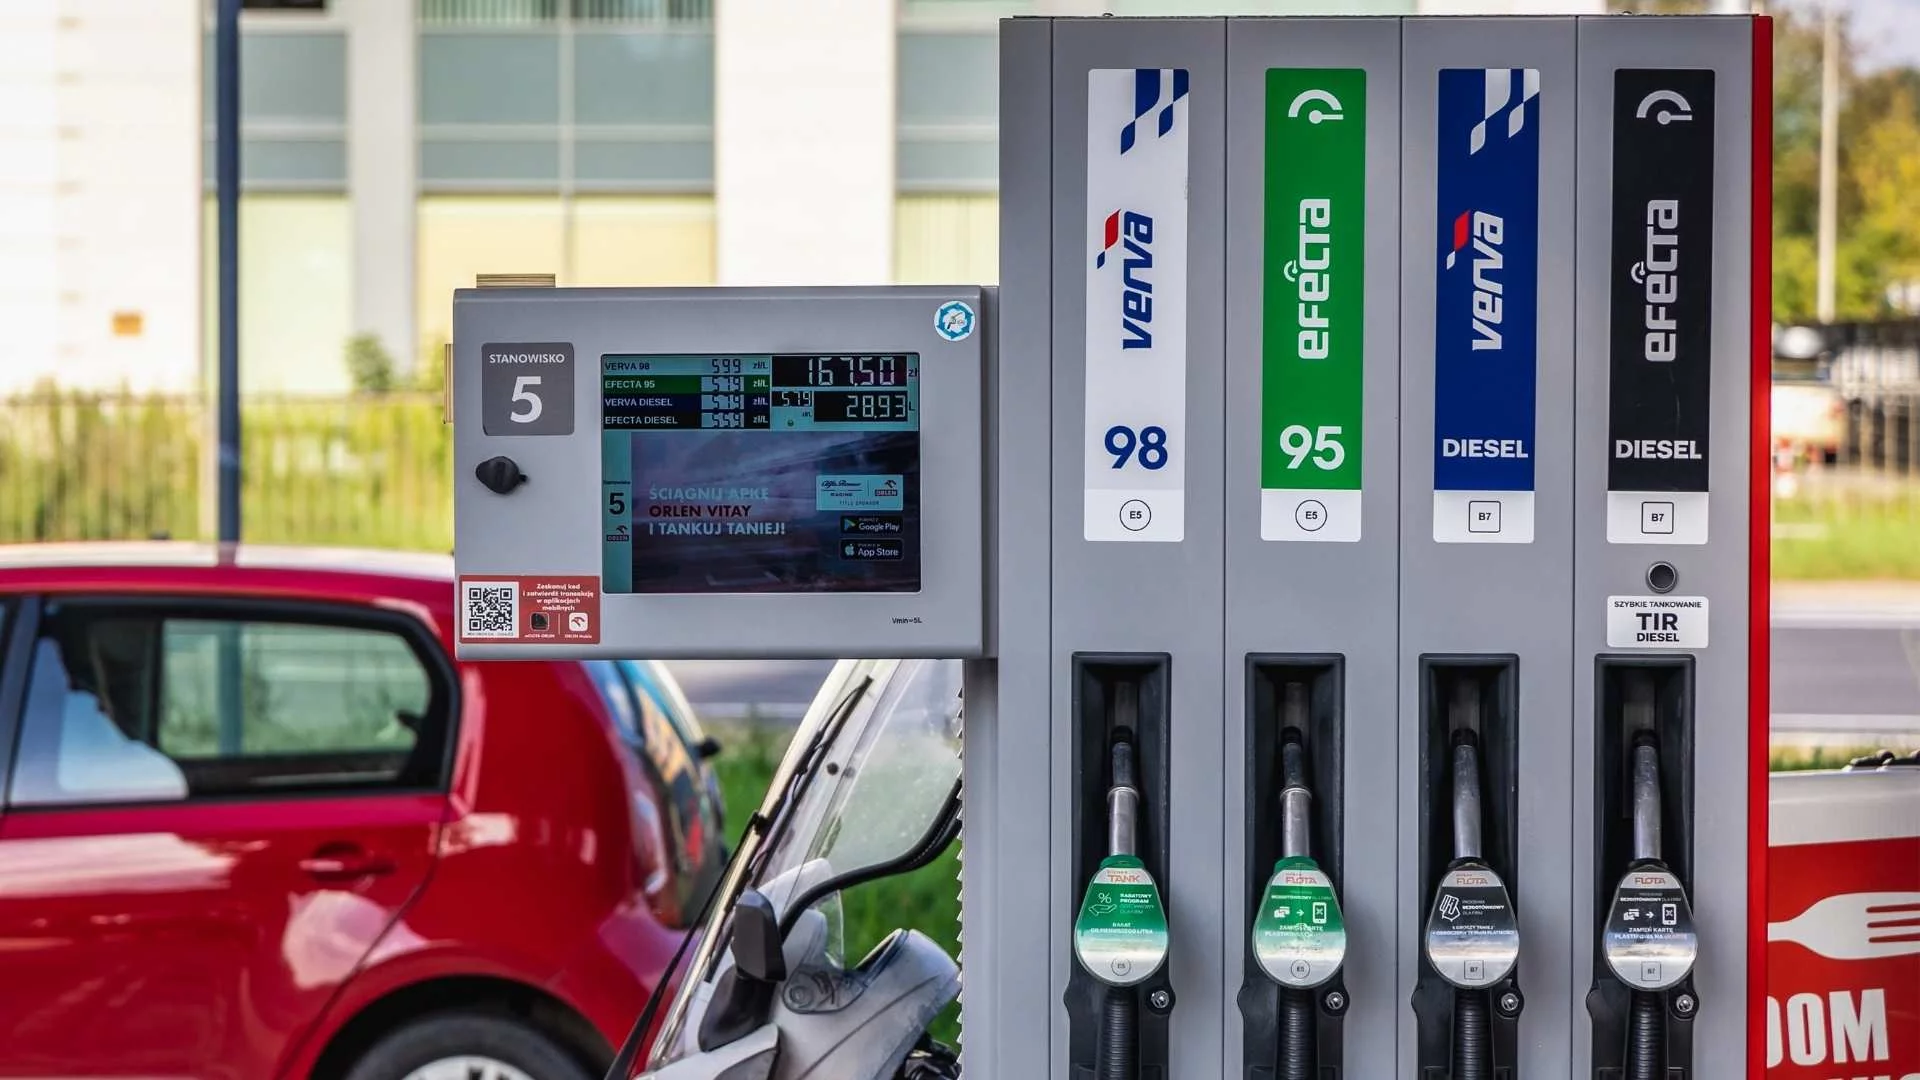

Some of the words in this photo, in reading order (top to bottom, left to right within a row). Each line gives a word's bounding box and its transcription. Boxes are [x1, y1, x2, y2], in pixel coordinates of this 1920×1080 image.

[1123, 211, 1153, 350] verva
[1473, 211, 1504, 351] verva
[489, 353, 565, 364] STANOWISKO
[605, 362, 637, 371] VERVA
[639, 362, 650, 371] 98
[605, 380, 642, 389] EFECTA
[643, 380, 656, 389] 95
[510, 376, 543, 423] 5
[605, 397, 637, 407] VERVA
[639, 397, 673, 407] DIESEL
[605, 416, 642, 425] EFECTA
[644, 416, 678, 425] DIESEL
[1104, 425, 1168, 471] 98
[1279, 424, 1345, 471] 95
[1443, 439, 1529, 458] DIESEL
[1615, 440, 1703, 459] DIESEL
[649, 482, 722, 503] ŚCIĄGNIJ
[609, 492, 626, 515] 5
[649, 505, 701, 518] ORLEN
[707, 505, 752, 517] VITAY
[1129, 507, 1142, 519] E5
[1305, 507, 1318, 519] E5
[1478, 512, 1492, 521] B7
[1651, 513, 1665, 522] B7
[649, 522, 654, 535] I
[658, 522, 722, 535] TANKUJ
[727, 522, 786, 535] TANIEJ!
[858, 522, 884, 532] Google
[885, 522, 900, 532] Play
[858, 548, 875, 556] App
[876, 547, 899, 556] Store
[1636, 613, 1679, 631] TIR
[1637, 633, 1680, 642] DIESEL
